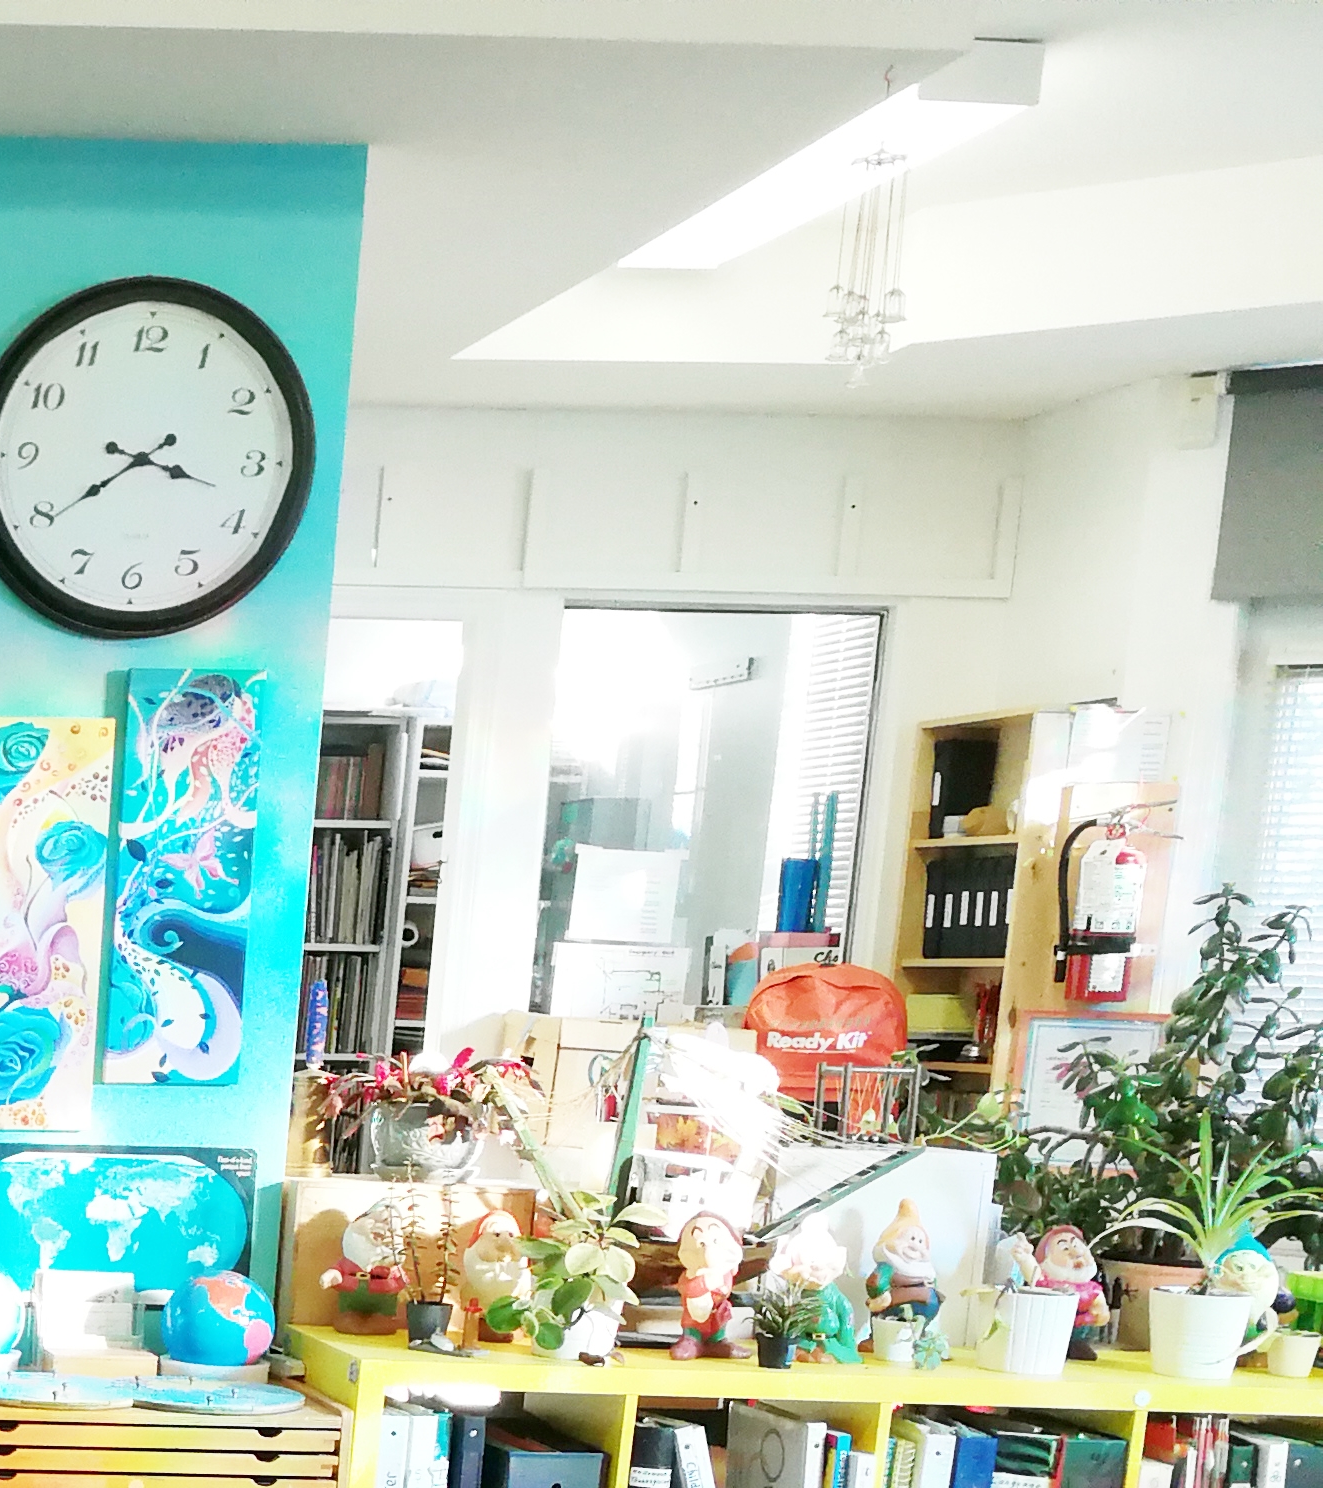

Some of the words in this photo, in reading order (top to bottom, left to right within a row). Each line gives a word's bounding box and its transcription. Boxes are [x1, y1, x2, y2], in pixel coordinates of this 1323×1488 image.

[75, 340, 100, 367] 11
[132, 325, 169, 354] 12
[198, 343, 211, 369] 1
[31, 382, 66, 411] 10
[228, 387, 256, 416] 2
[17, 441, 39, 470] 9
[240, 449, 266, 478] 3
[29, 501, 56, 528] 8
[220, 508, 246, 535] 4
[71, 548, 95, 576] 7
[121, 561, 144, 590] 6
[174, 549, 202, 577] 5
[766, 1031, 836, 1053] Ready
[836, 1031, 868, 1050] Kit
